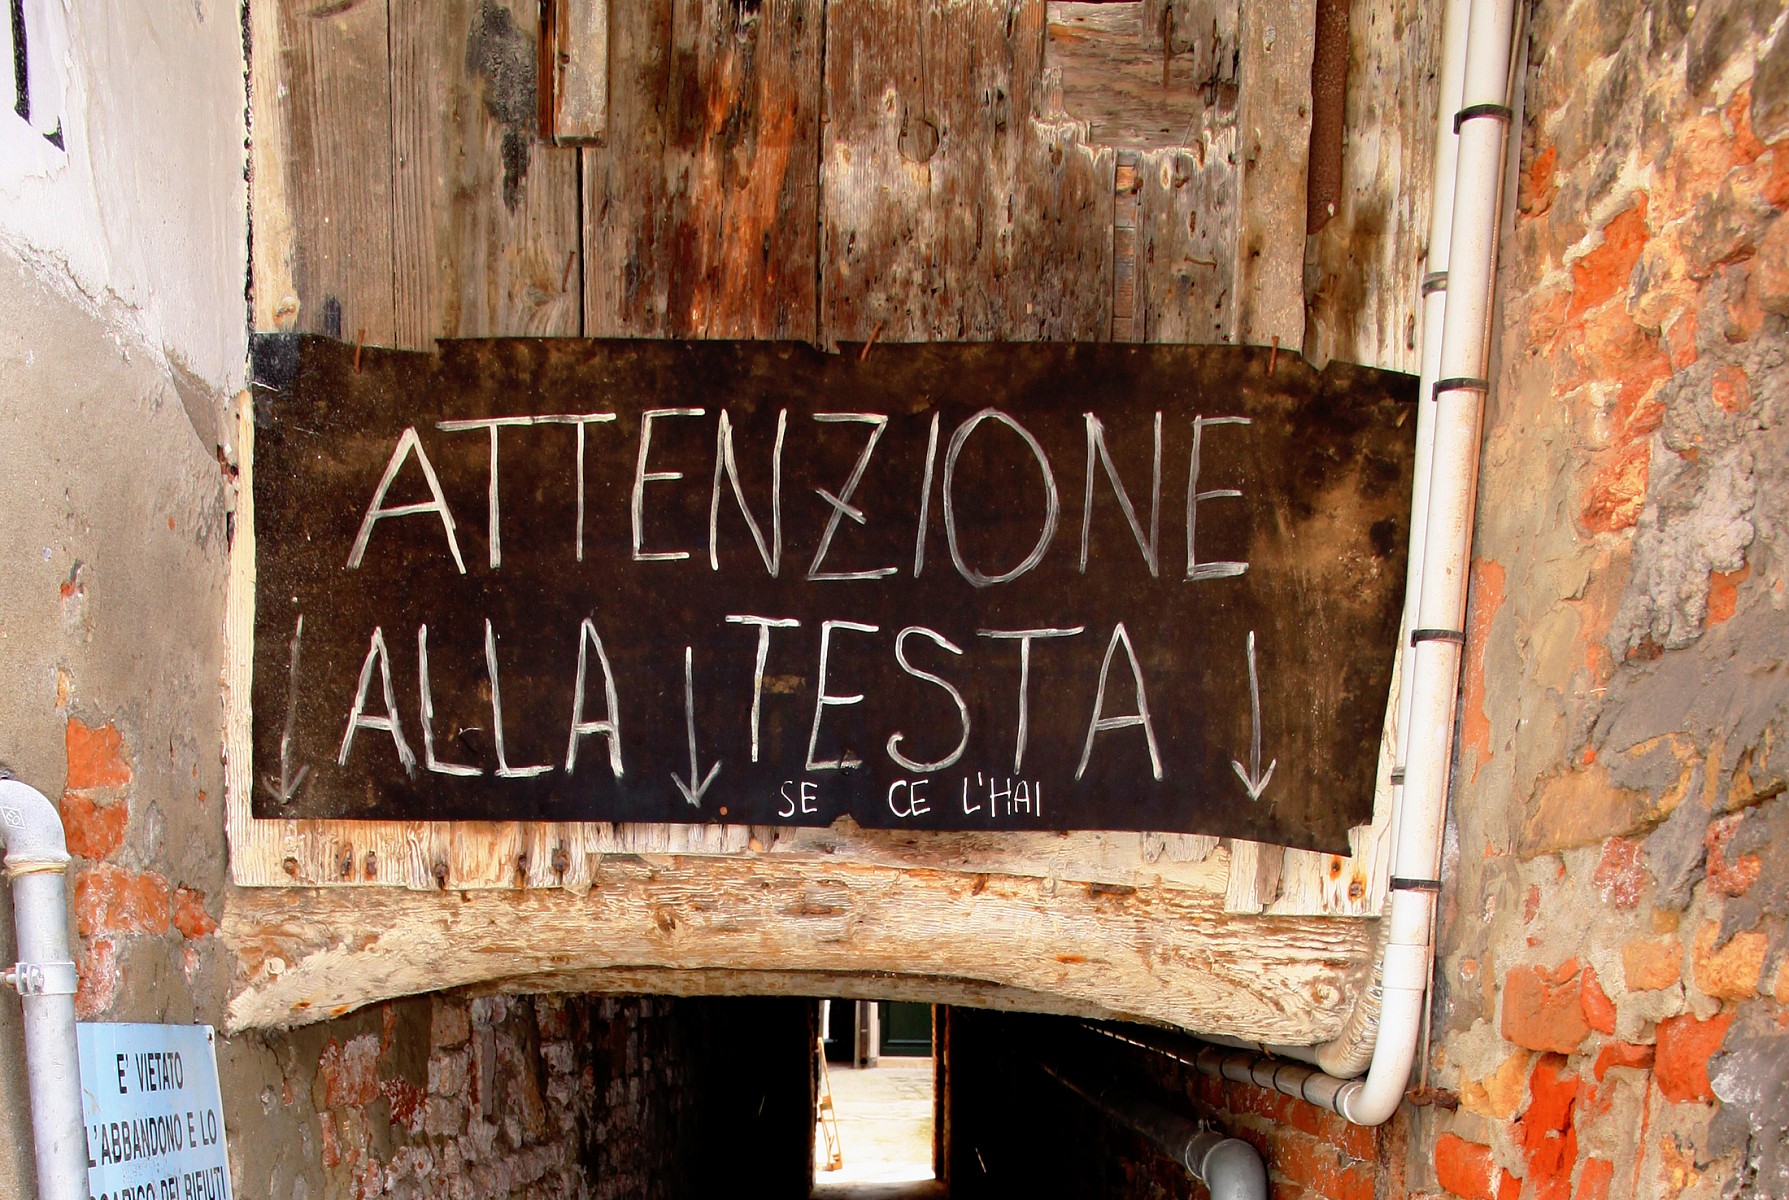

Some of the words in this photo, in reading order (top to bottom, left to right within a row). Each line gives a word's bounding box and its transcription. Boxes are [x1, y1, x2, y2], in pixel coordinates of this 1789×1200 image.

[346, 408, 1253, 589] ATTENZIONE
[337, 615, 625, 779] ALLA
[724, 614, 1164, 782] TESTA
[778, 780, 818, 817] SE
[888, 779, 931, 817] CE
[963, 772, 1041, 817] L'HAI
[116, 1053, 129, 1094] E'
[135, 1051, 184, 1092] VIETATO
[84, 1113, 183, 1169] L'ABBANDONO
[186, 1111, 197, 1148] E
[199, 1108, 218, 1146] LO
